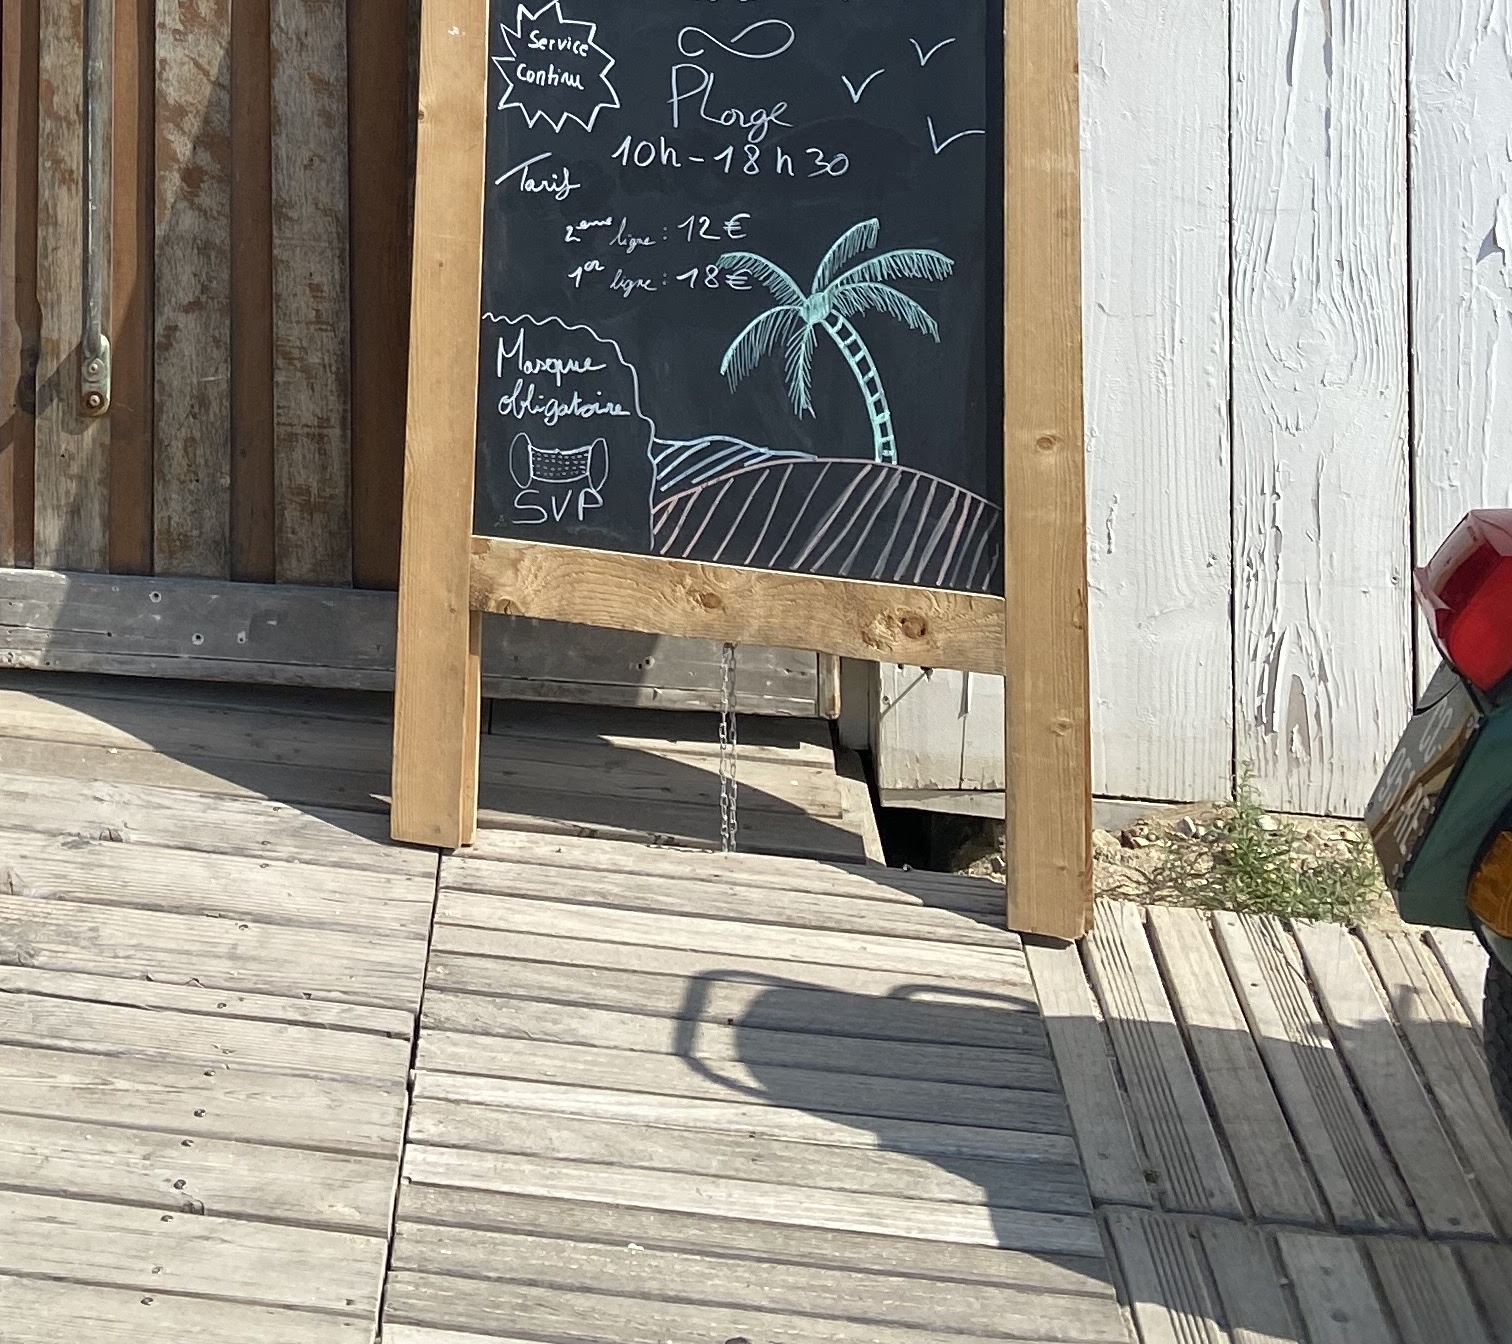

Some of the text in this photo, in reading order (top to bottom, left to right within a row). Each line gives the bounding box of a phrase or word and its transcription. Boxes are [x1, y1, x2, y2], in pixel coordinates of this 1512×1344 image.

[527, 29, 589, 57] Service
[494, 151, 582, 201] Tarif
[496, 327, 607, 387] Masque
[497, 378, 632, 427] obligatoire
[511, 488, 604, 525] SVP
